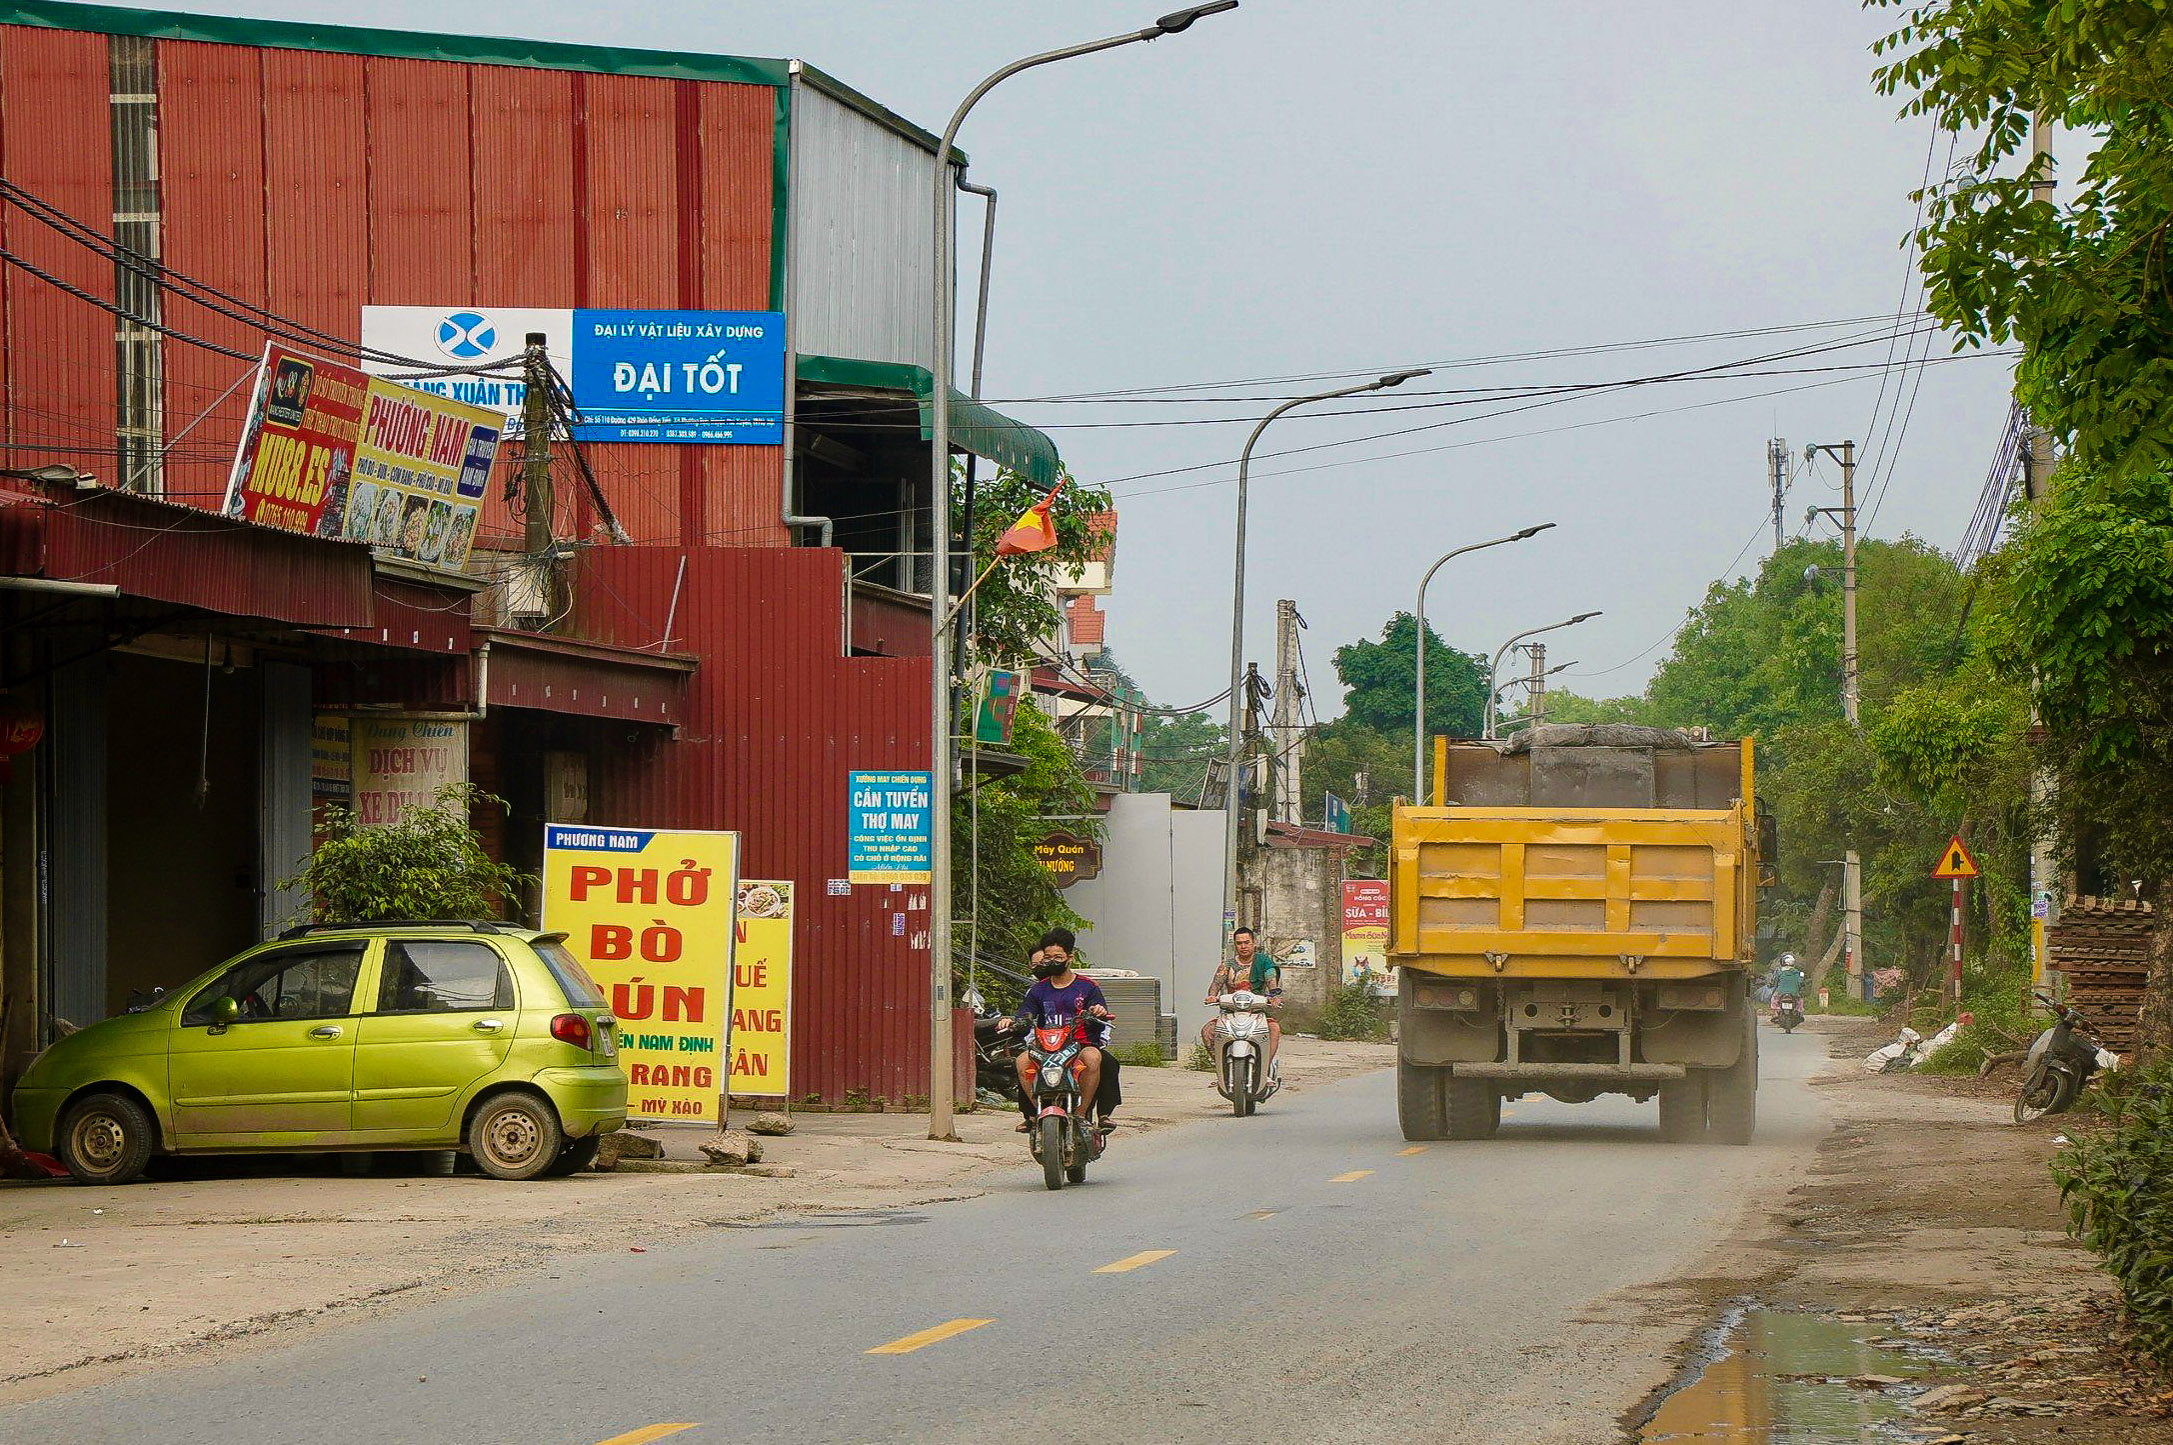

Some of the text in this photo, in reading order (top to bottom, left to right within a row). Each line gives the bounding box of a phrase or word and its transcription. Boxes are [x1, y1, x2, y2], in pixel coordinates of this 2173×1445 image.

[594, 320, 764, 342] ĐẠI LÝ VẬT LIỆU XÂY DỰNG
[613, 348, 743, 401] ĐẠI TỐT
[452, 377, 501, 406] XUÂN
[504, 383, 527, 406] TH
[427, 413, 470, 468] NAM
[249, 431, 331, 507] MU88.ES
[368, 747, 449, 781] DỊCH VỤ
[358, 791, 383, 825] XE
[853, 786, 928, 809] CẦN TUYỂN
[862, 811, 919, 833] THỢ MAY
[556, 832, 639, 849] PHƯƠNG NAM
[854, 834, 876, 843] CÔNG
[876, 834, 894, 844] VIỆC
[863, 845, 878, 853] THU
[902, 845, 918, 853] CAO
[1057, 844, 1084, 854] Quán
[570, 859, 712, 907] PHỞ
[1345, 905, 1367, 919] SỮA
[590, 919, 683, 963] BÒ
[735, 957, 767, 988] UẾ
[596, 977, 705, 1023] ÚN
[732, 1008, 782, 1033] ANG
[638, 1034, 674, 1051] NAM
[678, 1036, 714, 1056] ĐỊNH
[630, 1063, 712, 1088] RANG
[641, 1096, 703, 1115] MỲ XÀO
